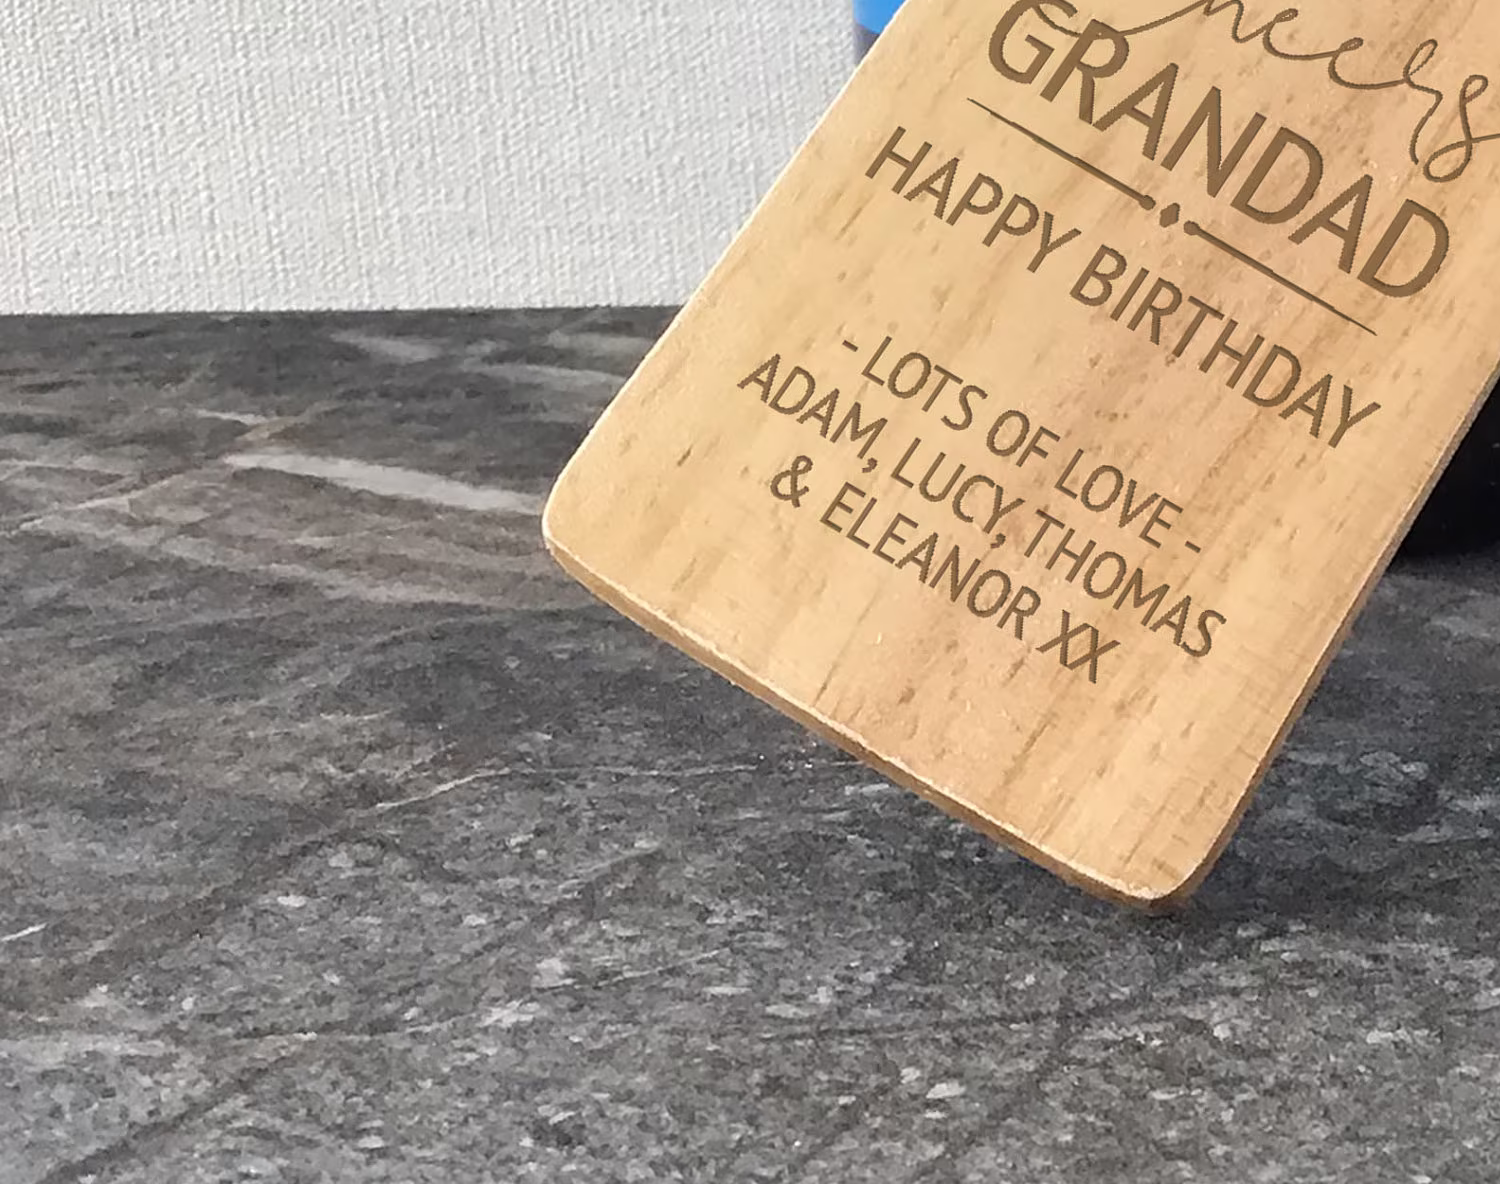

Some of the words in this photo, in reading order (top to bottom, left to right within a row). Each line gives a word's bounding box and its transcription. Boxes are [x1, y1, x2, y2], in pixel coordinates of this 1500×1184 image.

[864, 126, 1081, 273] HAPPY
[1069, 244, 1381, 449] BIRTHDAY
[737, 353, 888, 474] ADAM,
[890, 437, 1025, 549] LUCY,
[1023, 508, 1227, 658] THOMAS
[769, 454, 814, 508] &
[819, 481, 1042, 641] ELEANOR
[1034, 609, 1121, 684] XX
[861, 336, 988, 431] LOTS
[986, 409, 1060, 467] OF
[1055, 448, 1184, 549] LOVE
